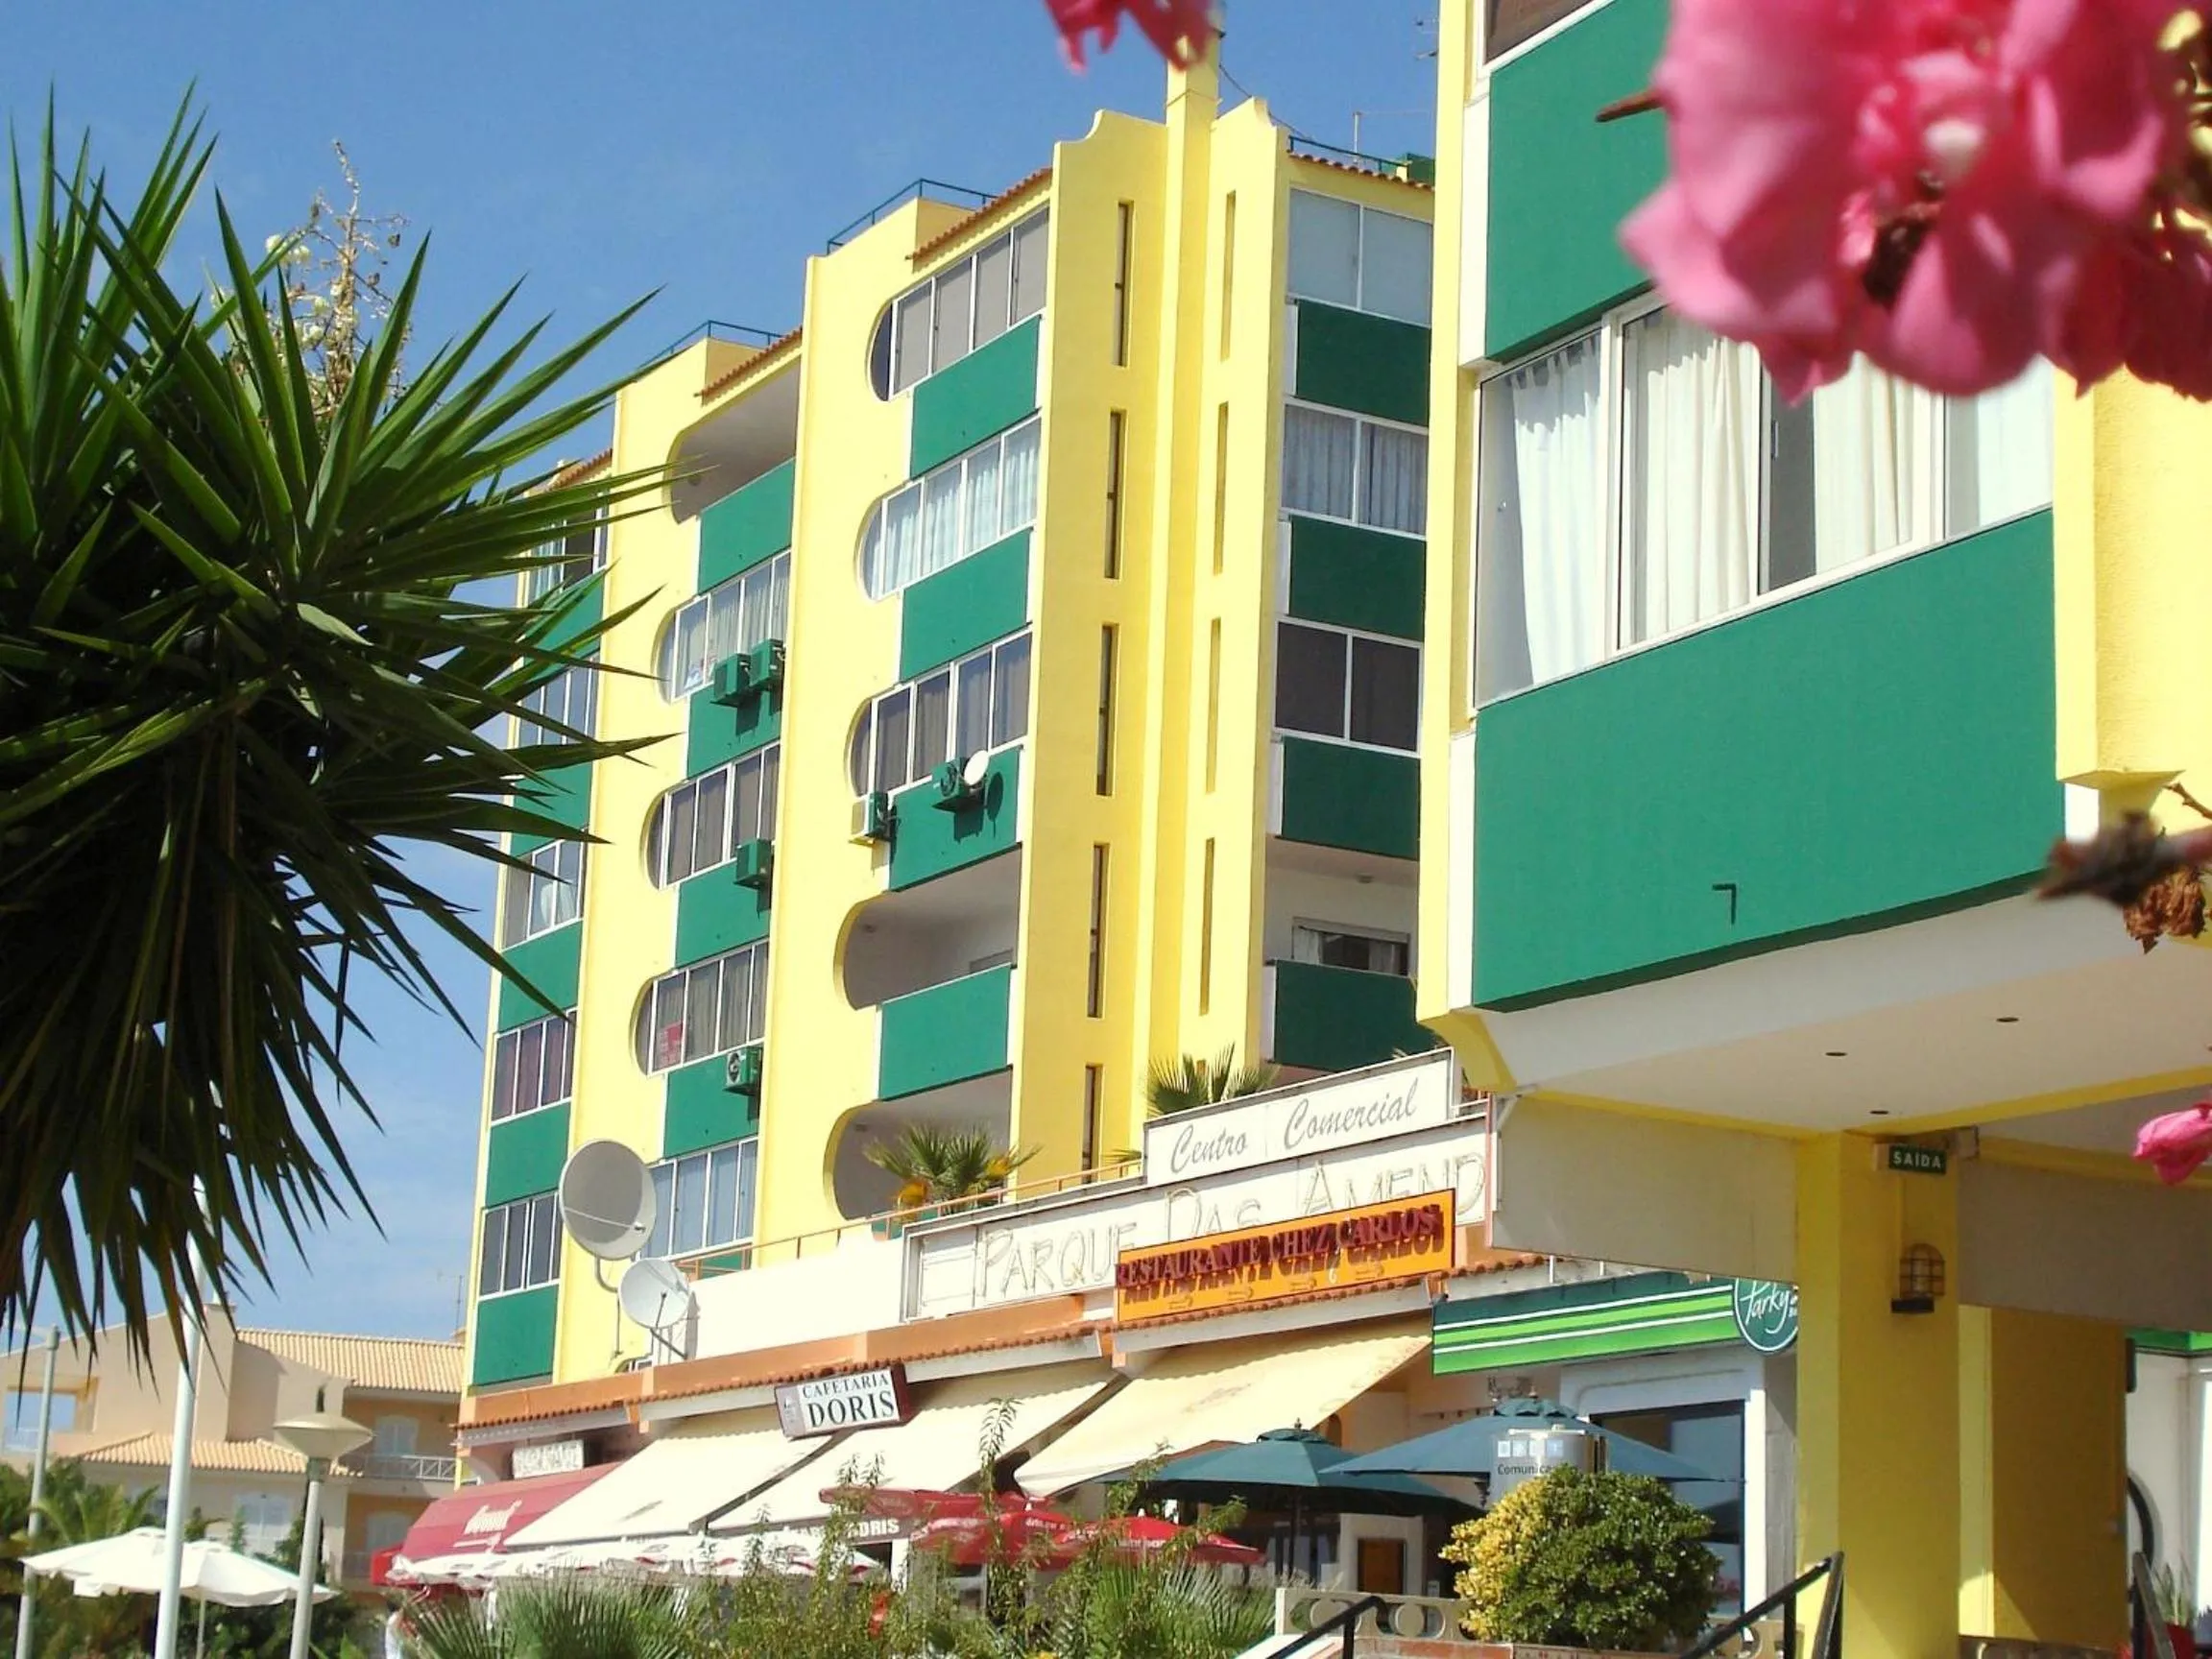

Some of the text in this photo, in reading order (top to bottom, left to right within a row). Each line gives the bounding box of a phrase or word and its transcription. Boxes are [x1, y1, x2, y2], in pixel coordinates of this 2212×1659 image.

[1170, 1077, 1419, 1173] Centro Comercial
[1271, 1224, 1334, 1260] CHEZ
[1337, 1205, 1442, 1248] CARLOS
[803, 1373, 889, 1398] CAFETARIA
[807, 1390, 895, 1428] DORIS
